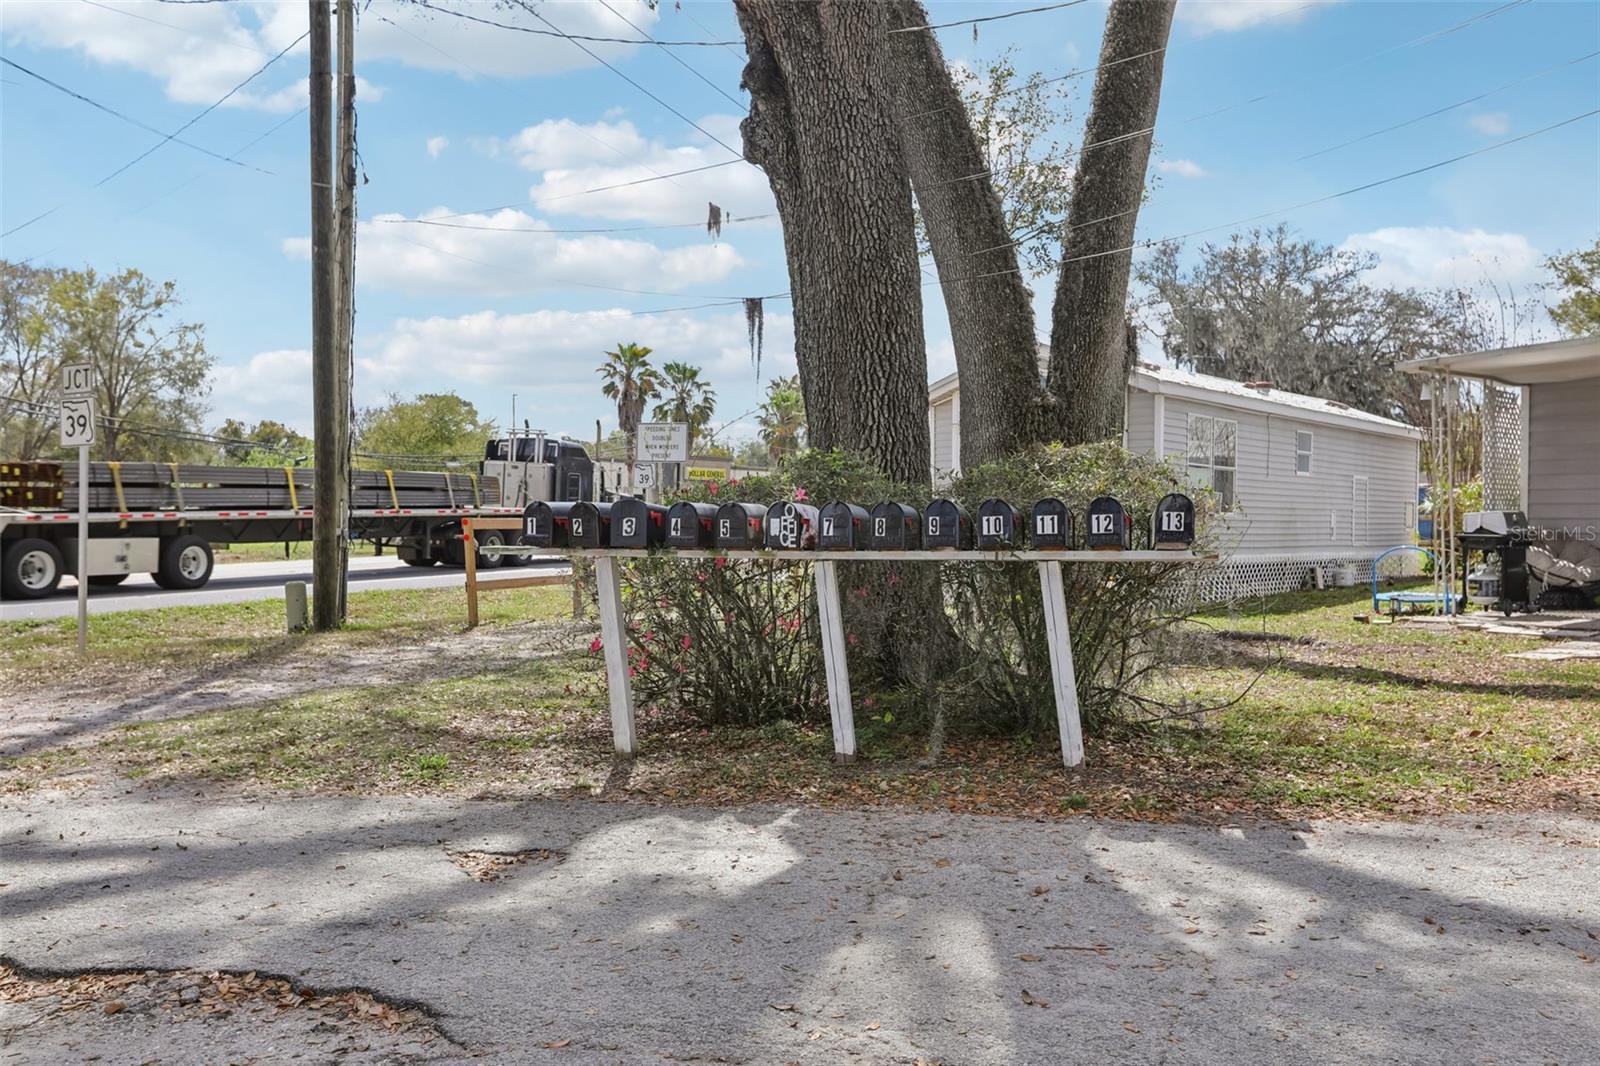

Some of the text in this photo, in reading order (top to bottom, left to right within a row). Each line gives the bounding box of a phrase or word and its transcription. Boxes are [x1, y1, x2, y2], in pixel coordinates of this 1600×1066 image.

[65, 369, 89, 390] JCT
[65, 415, 87, 437] 39
[640, 474, 650, 484] 39
[529, 518, 535, 534] 1
[573, 519, 582, 535] 2
[624, 518, 634, 535] 3
[672, 518, 680, 535] 4
[721, 519, 729, 537] 5
[824, 518, 833, 536] 7
[876, 518, 885, 536] 8
[930, 517, 939, 534] 9
[984, 517, 1002, 534] 10
[1039, 515, 1058, 534] 11
[1094, 515, 1112, 533] 12
[1165, 512, 1183, 531] 13
